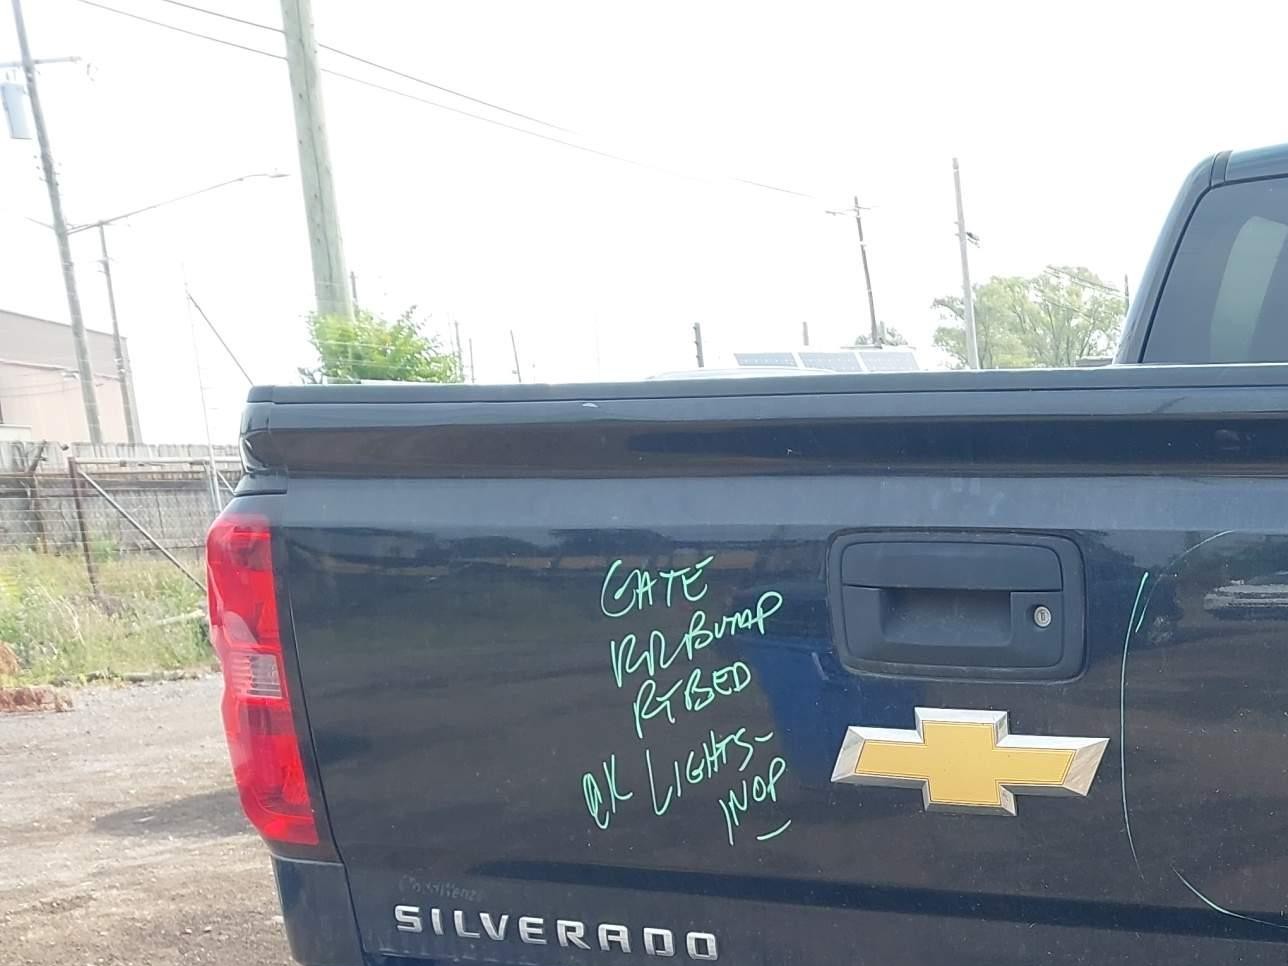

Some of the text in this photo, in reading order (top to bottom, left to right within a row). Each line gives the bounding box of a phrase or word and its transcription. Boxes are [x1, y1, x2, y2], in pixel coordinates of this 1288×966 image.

[601, 556, 714, 617] GATE
[684, 661, 751, 712] BED
[394, 905, 718, 961] SILVERADO
